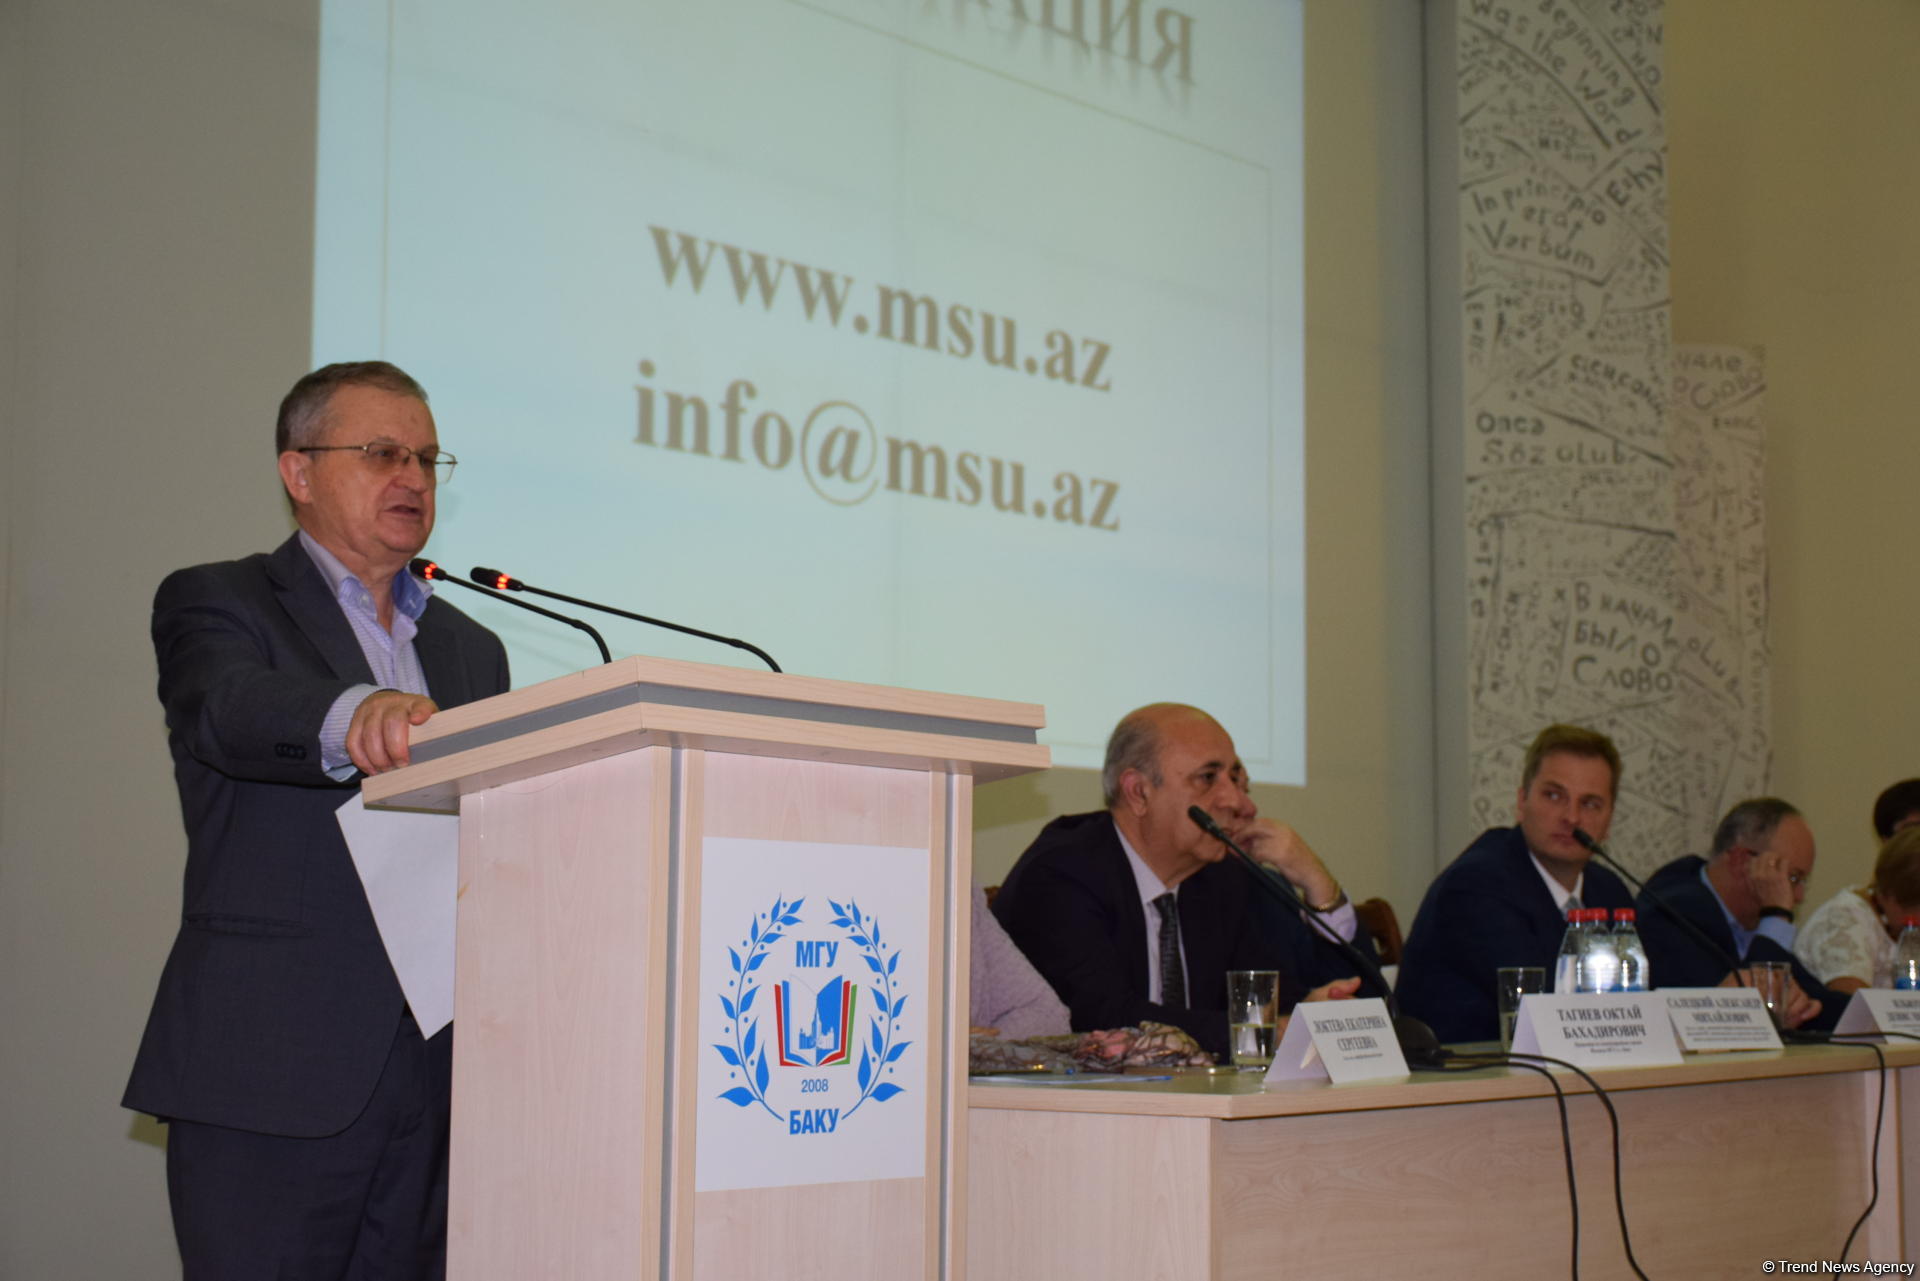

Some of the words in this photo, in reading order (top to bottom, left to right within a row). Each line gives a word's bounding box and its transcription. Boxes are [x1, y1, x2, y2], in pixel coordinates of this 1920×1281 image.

[647, 224, 1112, 392] www.msu.az
[633, 359, 1121, 531] info@msu.az
[795, 940, 839, 968] МГУ
[1556, 1008, 1602, 1021] ТАГИЕВ
[1602, 1004, 1643, 1020] ОКТАЙ
[1562, 1024, 1647, 1039] БАХАДИРОВИЧ
[801, 1079, 829, 1093] 2008
[789, 1108, 840, 1135] БАКУ
